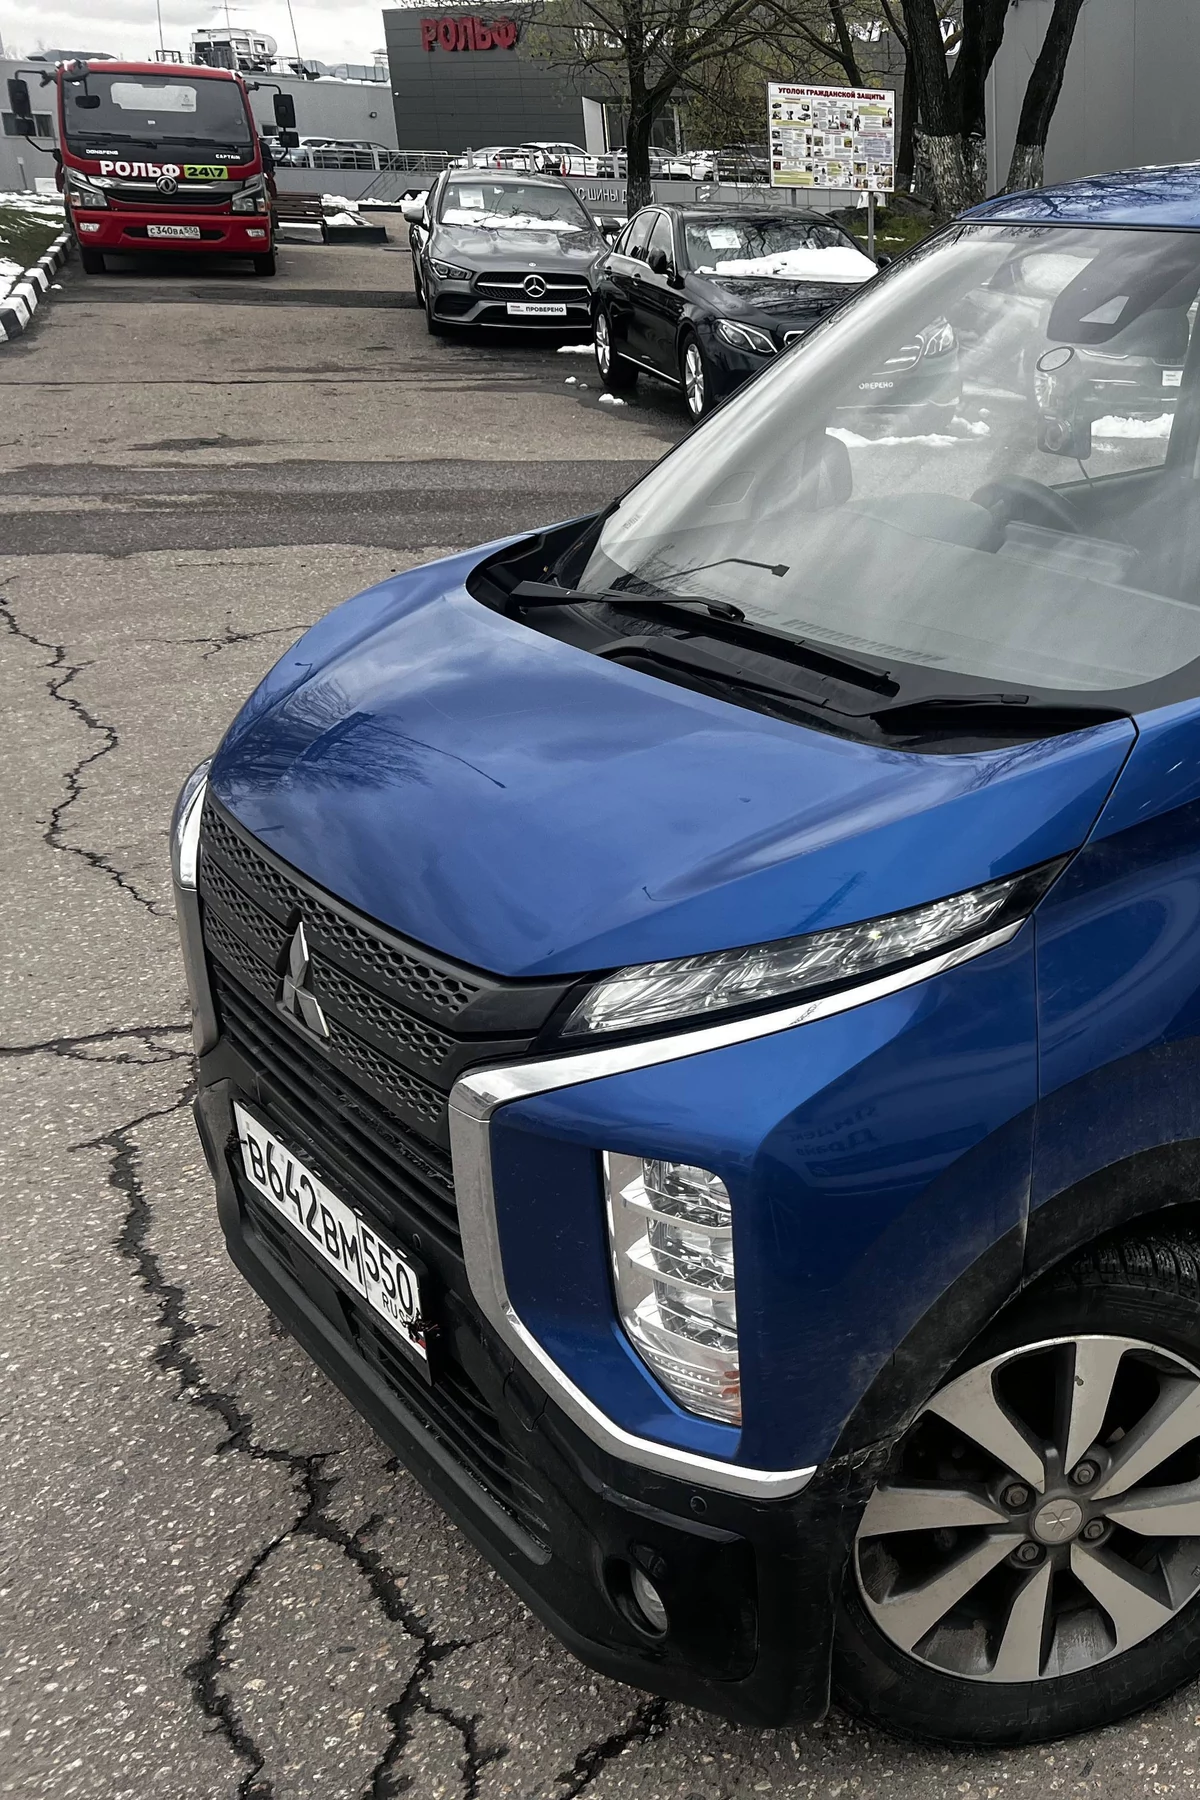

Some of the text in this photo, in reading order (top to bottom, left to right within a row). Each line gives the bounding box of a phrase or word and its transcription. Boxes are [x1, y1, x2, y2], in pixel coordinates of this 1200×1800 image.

[420, 16, 517, 51] РОЛЬФ
[778, 87, 885, 101] УГОЛОК ГРАЖДАНСКОЙ ЗАЩИТЫ
[100, 161, 180, 178] РОЛЬФ
[587, 187, 619, 202] ШИНЫ
[362, 1224, 414, 1316] 550
